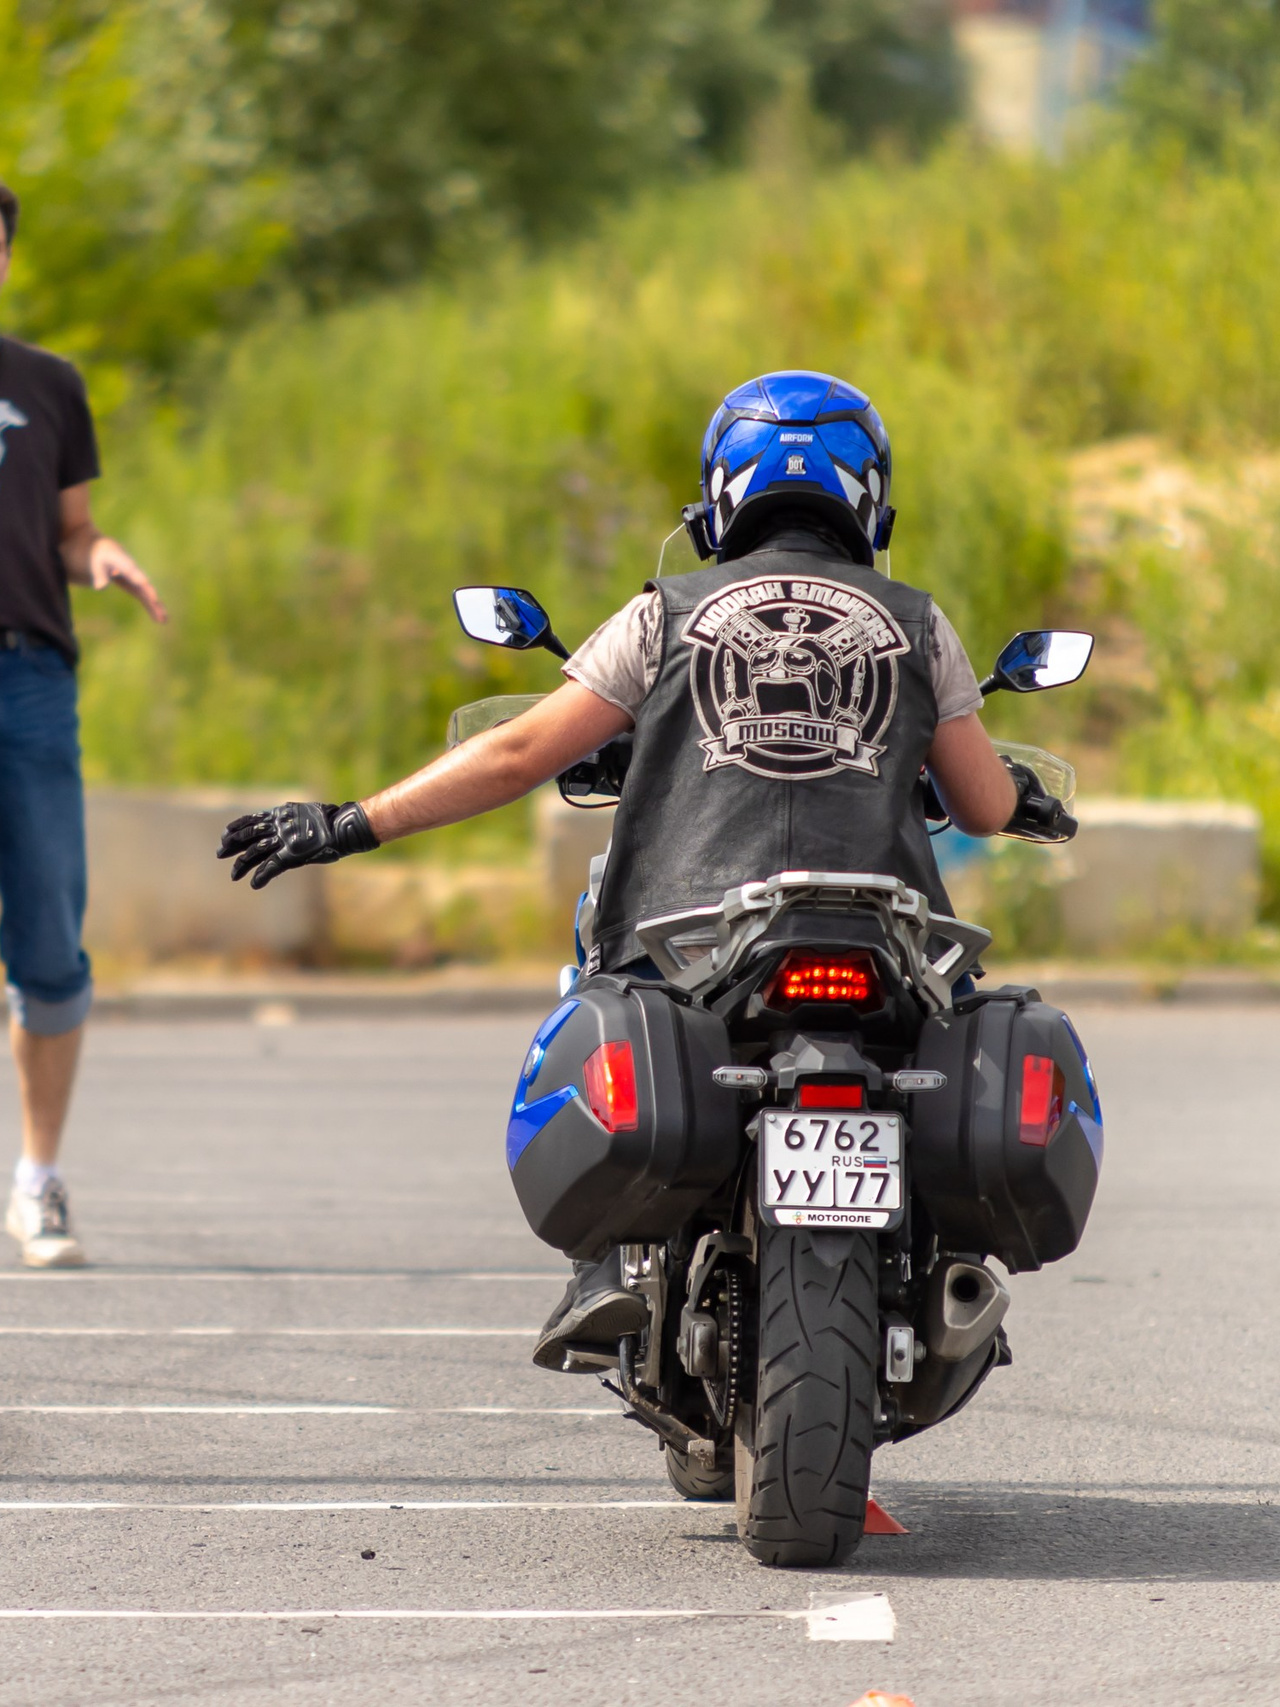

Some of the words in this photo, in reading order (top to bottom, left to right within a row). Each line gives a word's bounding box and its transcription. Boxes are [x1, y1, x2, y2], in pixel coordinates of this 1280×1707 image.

[694, 582, 786, 640] HOOKAH
[790, 582, 897, 649] SMOKERS
[738, 721, 839, 743] MOSCOW
[784, 1118, 880, 1152] 6762
[831, 1155, 863, 1168] RUS
[845, 1171, 890, 1205] 77
[807, 1213, 872, 1224] МОТОПОЛЕ
